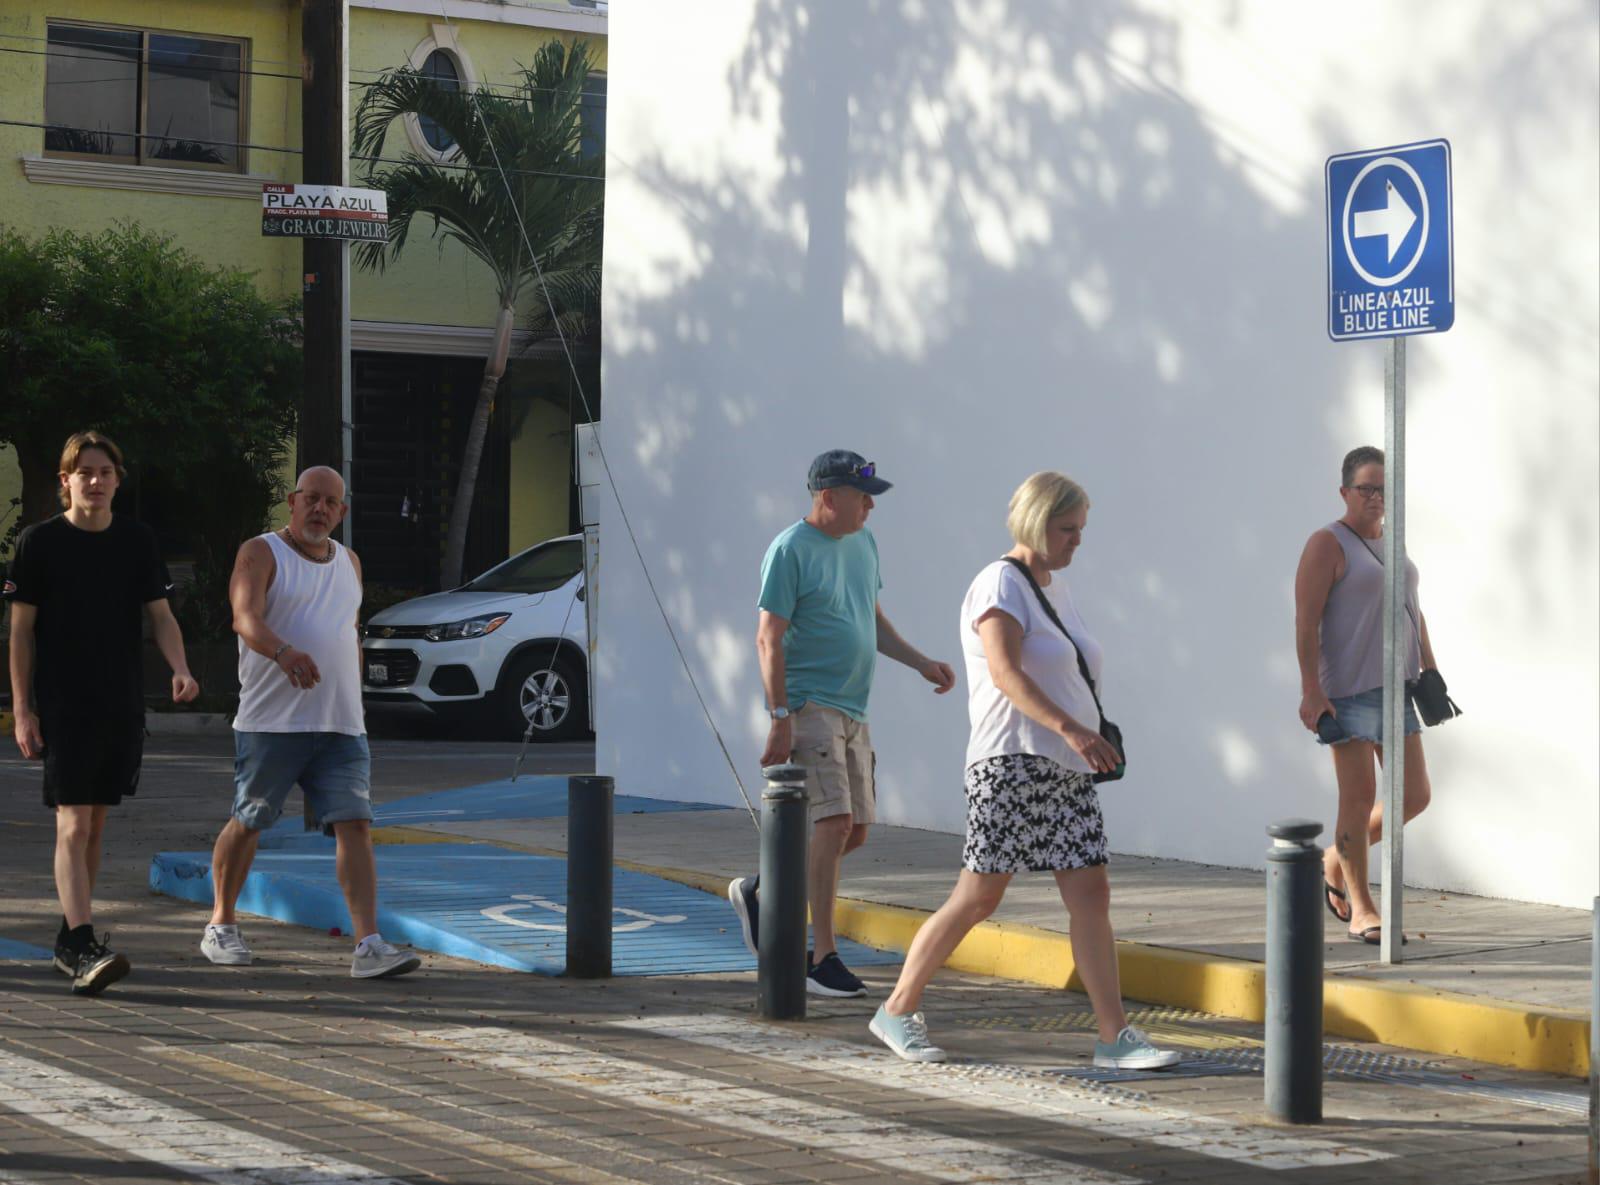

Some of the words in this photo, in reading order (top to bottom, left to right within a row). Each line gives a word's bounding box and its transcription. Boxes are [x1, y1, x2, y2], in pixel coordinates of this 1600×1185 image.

[268, 195, 334, 208] PLAYA
[339, 198, 376, 211] AZUL
[282, 219, 334, 234] GRACE
[337, 221, 388, 238] JEWELRY
[1340, 292, 1388, 313] LINEA
[1391, 288, 1434, 308] AZUL
[1344, 311, 1387, 332] BLUE
[1393, 307, 1430, 328] LINE
